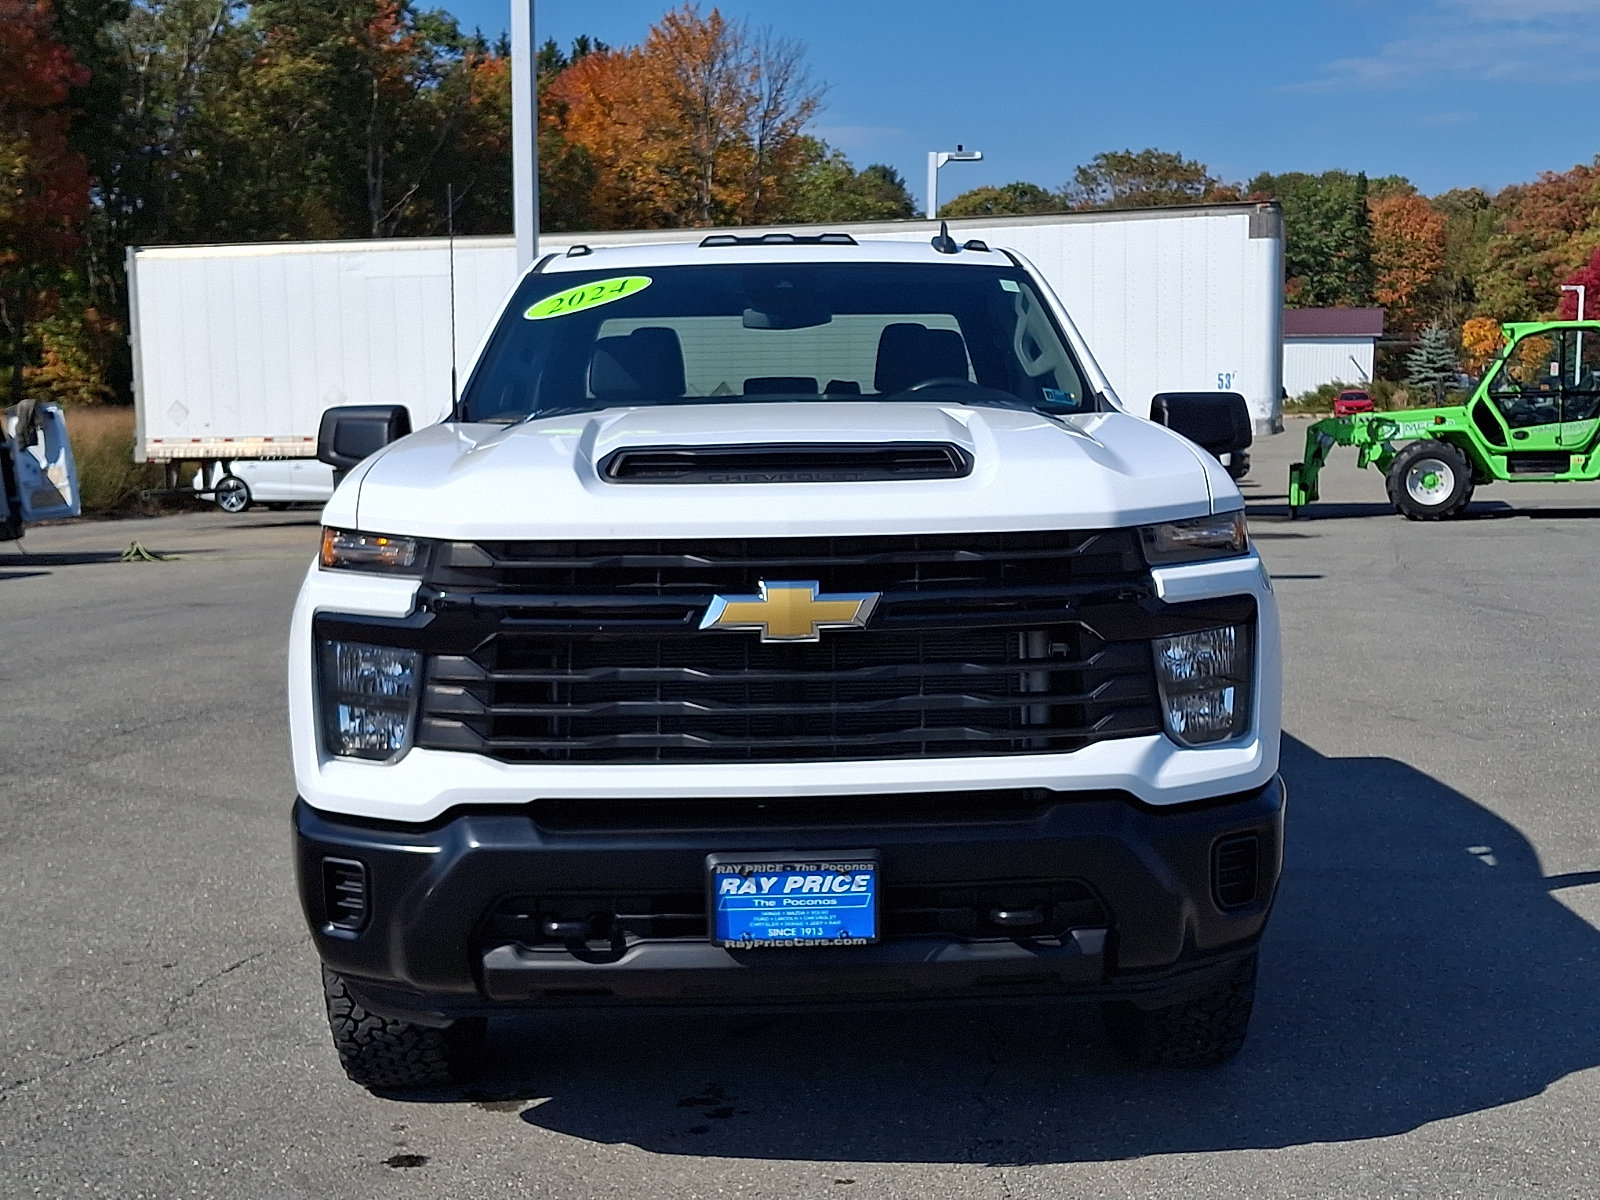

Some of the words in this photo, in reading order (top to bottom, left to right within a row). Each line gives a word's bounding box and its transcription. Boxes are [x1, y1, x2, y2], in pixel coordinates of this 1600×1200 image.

[547, 279, 629, 315] 2024
[1217, 373, 1235, 390] 53'
[716, 864, 742, 874] RAY
[745, 864, 784, 873] PRICE
[795, 863, 817, 872] The
[821, 863, 874, 872] Poconos
[719, 877, 779, 894] RAY
[783, 875, 871, 893] PRICE
[752, 899, 776, 907] The
[783, 898, 837, 906] Poconos
[768, 928, 797, 937] SINCE
[801, 927, 823, 936] 1913
[725, 937, 867, 950] RayPriceCars.com
